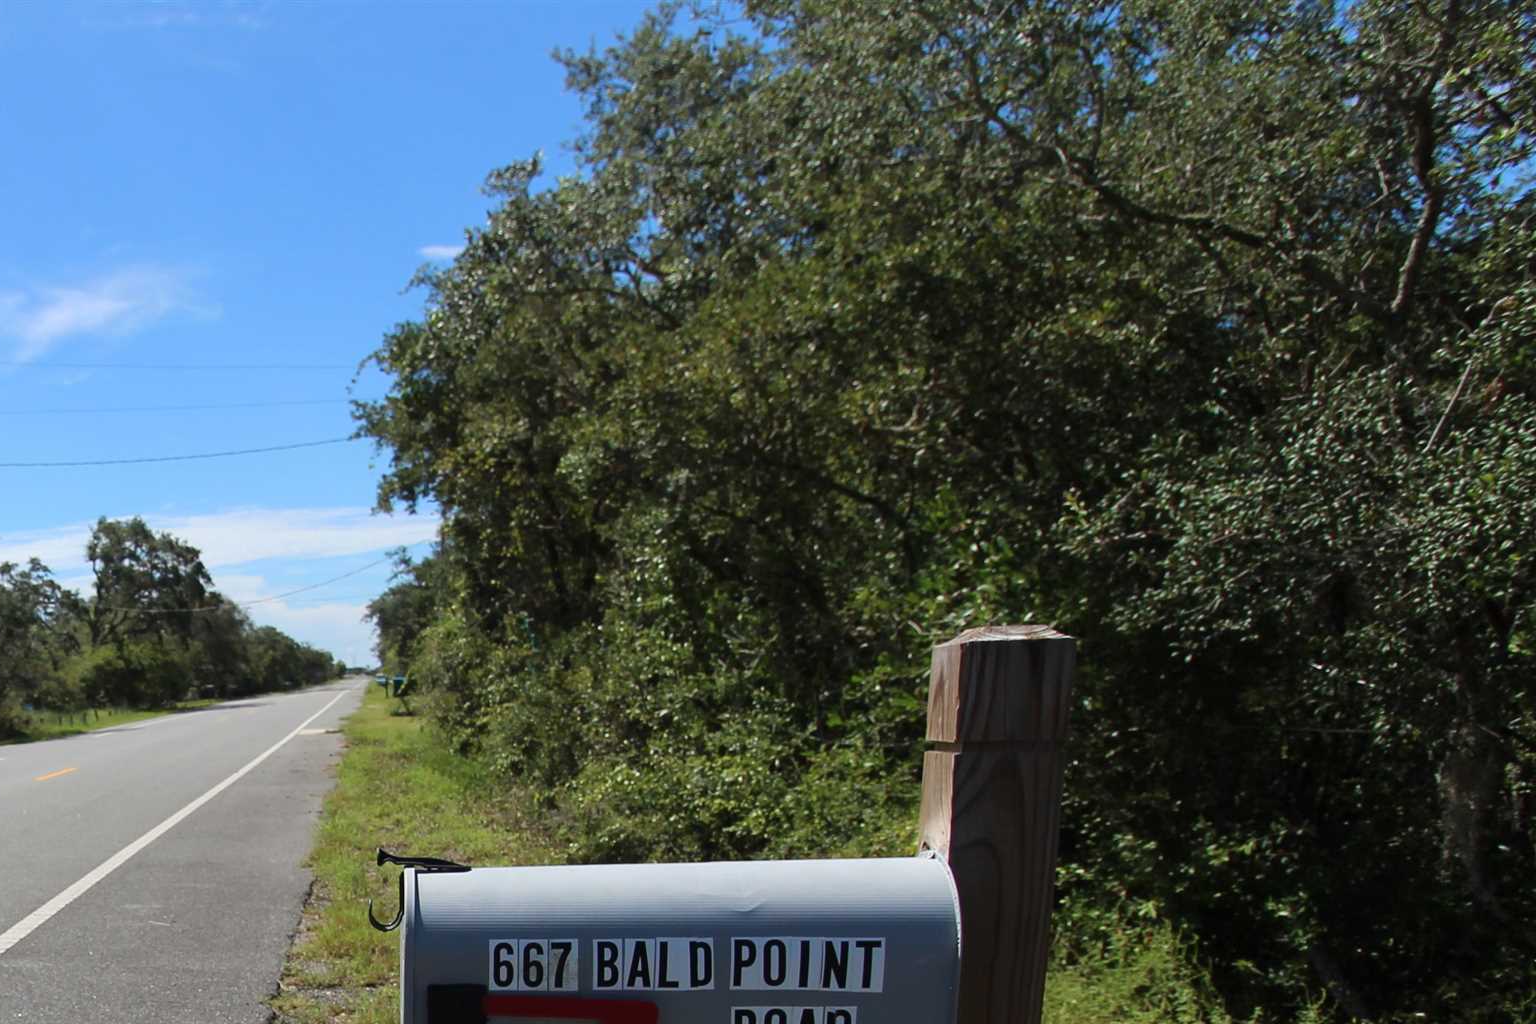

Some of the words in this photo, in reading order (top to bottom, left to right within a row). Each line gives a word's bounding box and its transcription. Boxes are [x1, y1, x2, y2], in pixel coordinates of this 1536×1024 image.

[492, 941, 572, 989] 667
[596, 939, 714, 989] BALD
[732, 939, 883, 989] POINT
